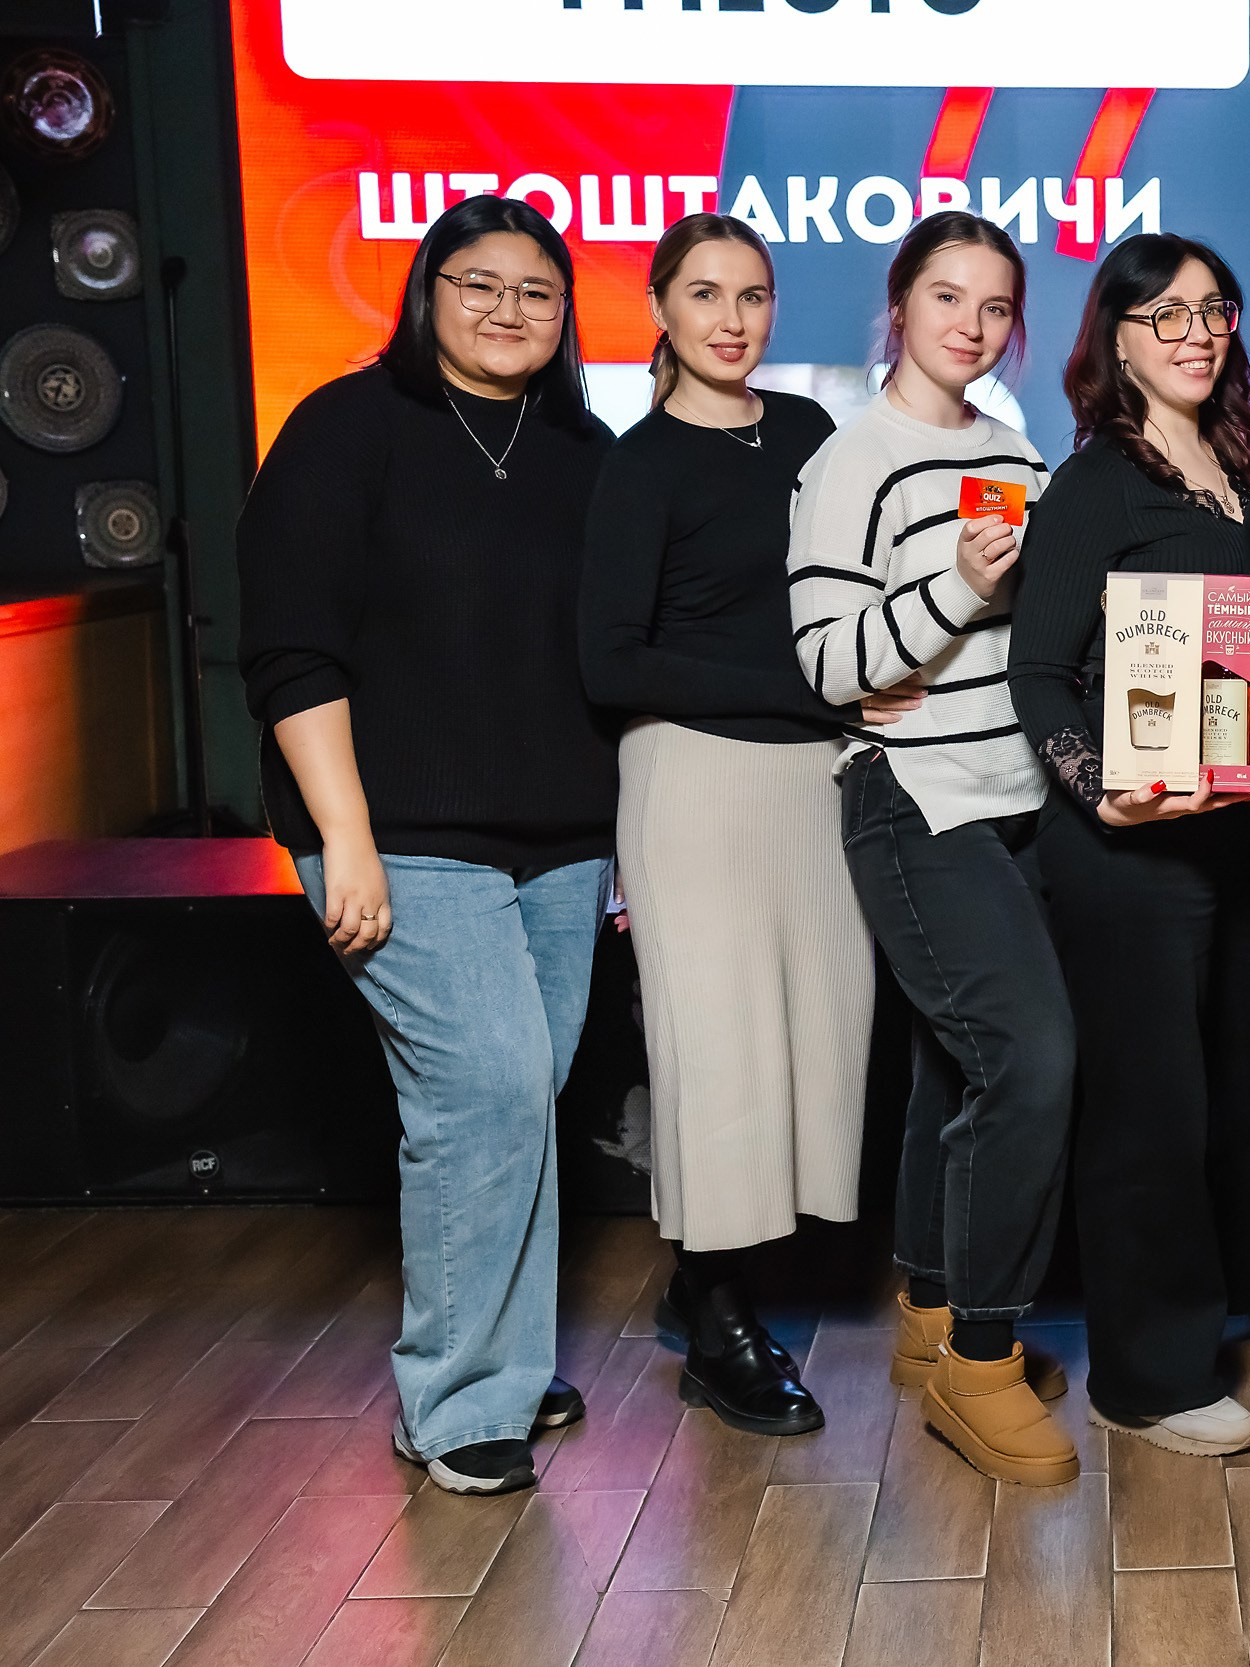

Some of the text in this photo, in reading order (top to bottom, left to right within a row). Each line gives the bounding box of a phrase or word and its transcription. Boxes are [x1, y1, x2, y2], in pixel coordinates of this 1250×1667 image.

[983, 493, 1002, 502] QUIZ
[1140, 609, 1166, 621] OLD
[1116, 623, 1190, 645] DUMBRECK
[1206, 694, 1222, 704] OLD
[1132, 709, 1172, 721] DUMBRECK
[192, 1157, 216, 1171] RCF
